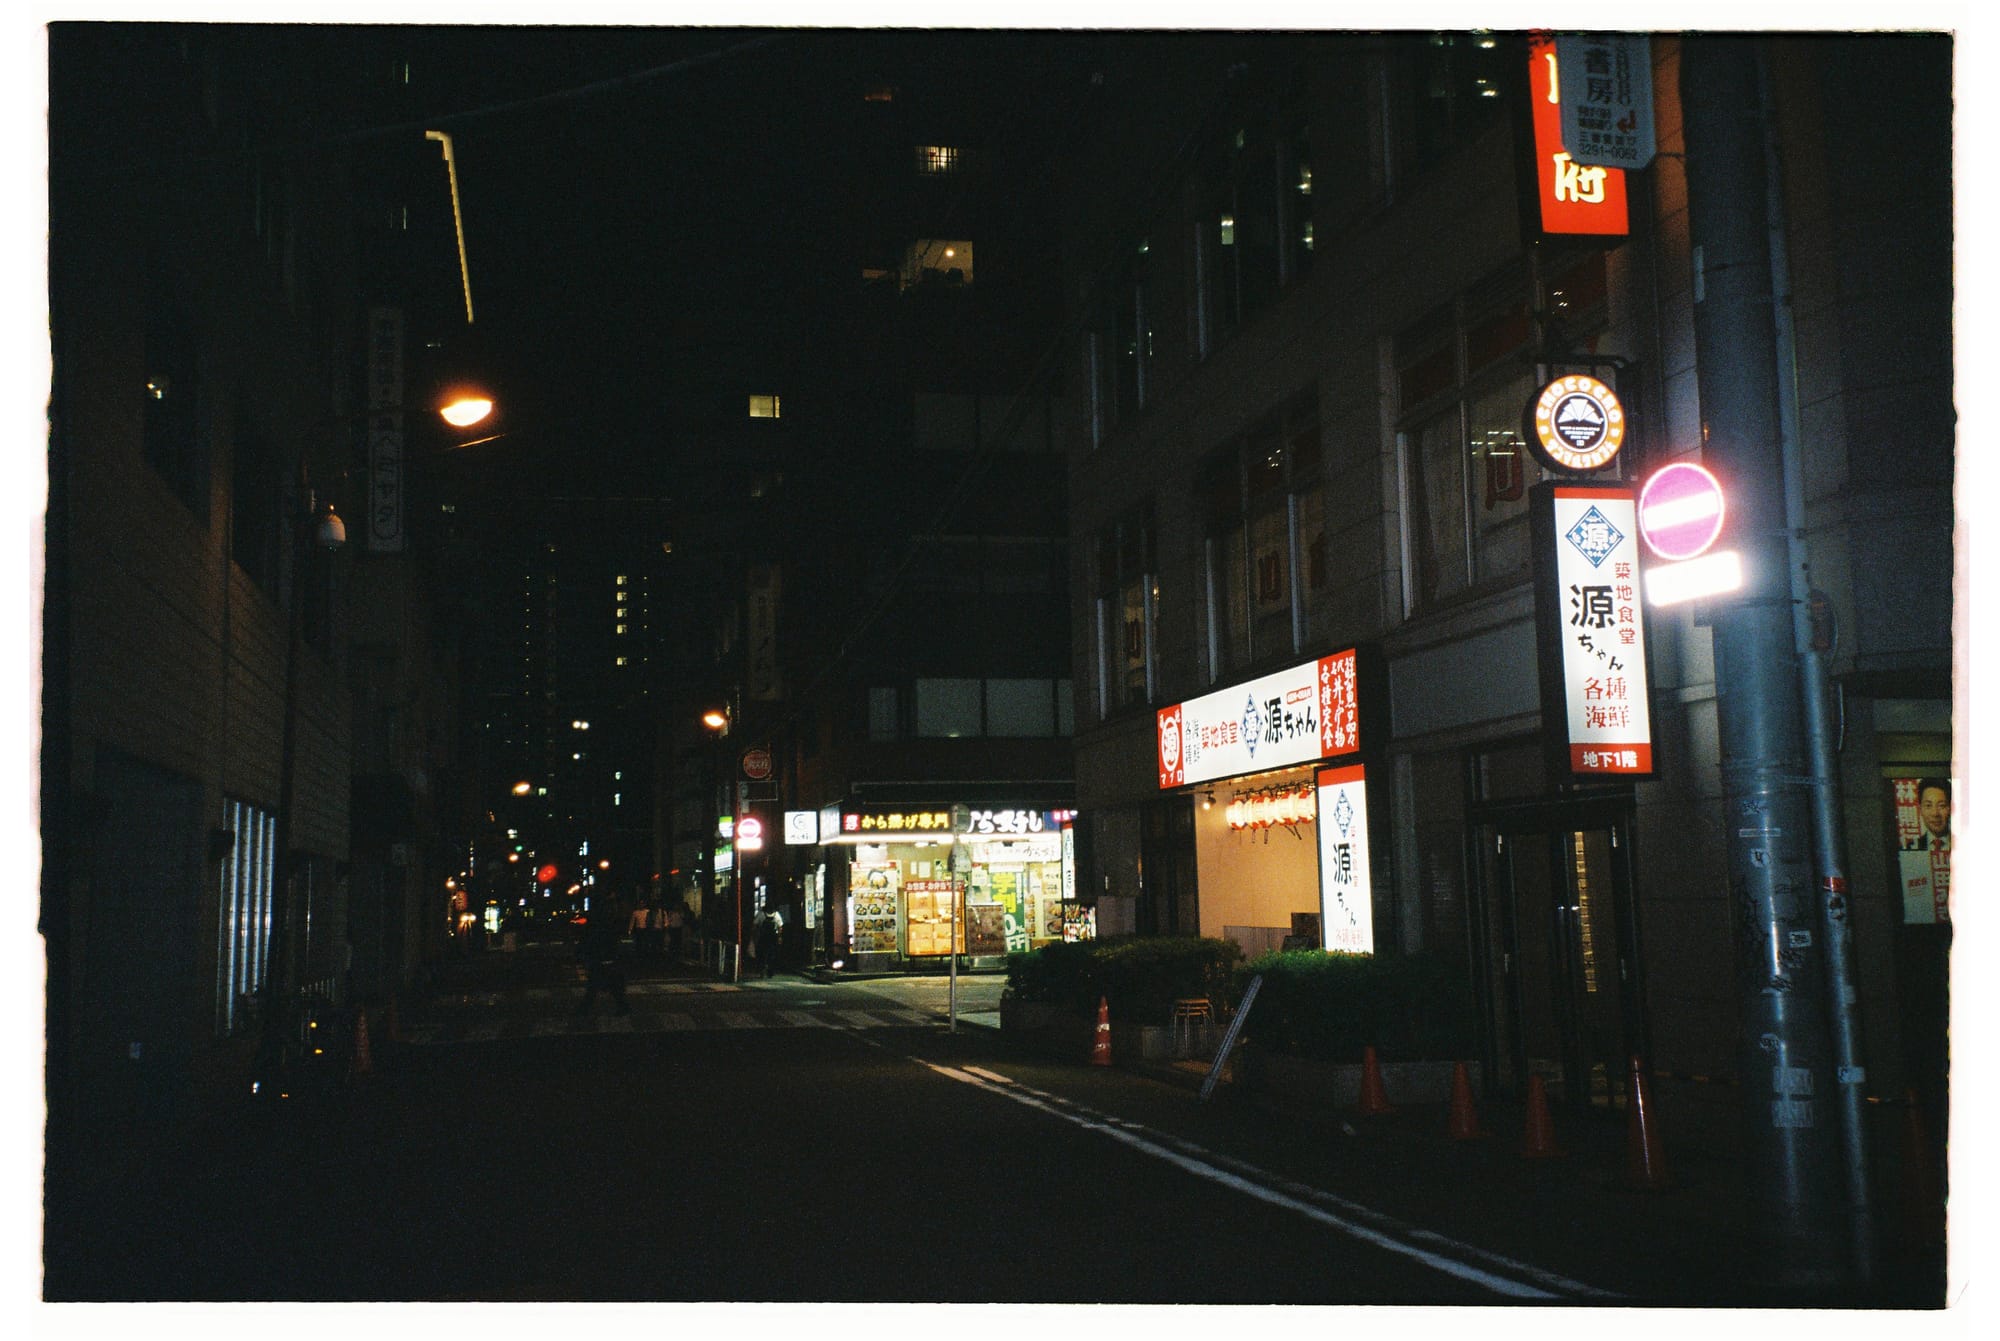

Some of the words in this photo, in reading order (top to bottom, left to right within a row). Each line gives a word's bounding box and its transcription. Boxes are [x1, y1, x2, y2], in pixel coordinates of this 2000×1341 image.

[1615, 562, 1636, 645] 築地食堂
[1569, 584, 1624, 671] 源ちゃん
[1583, 676, 1628, 701] 各種
[1264, 696, 1317, 744] 源ちゃん
[1585, 705, 1630, 729] 海鮮
[1201, 720, 1238, 749] 築地食堂
[1583, 751, 1638, 769] 地下1階
[992, 871, 1017, 913] 学割
[1333, 842, 1357, 926] 源ちゃん
[1004, 914, 1025, 936] 0%
[1006, 934, 1025, 952] FF
